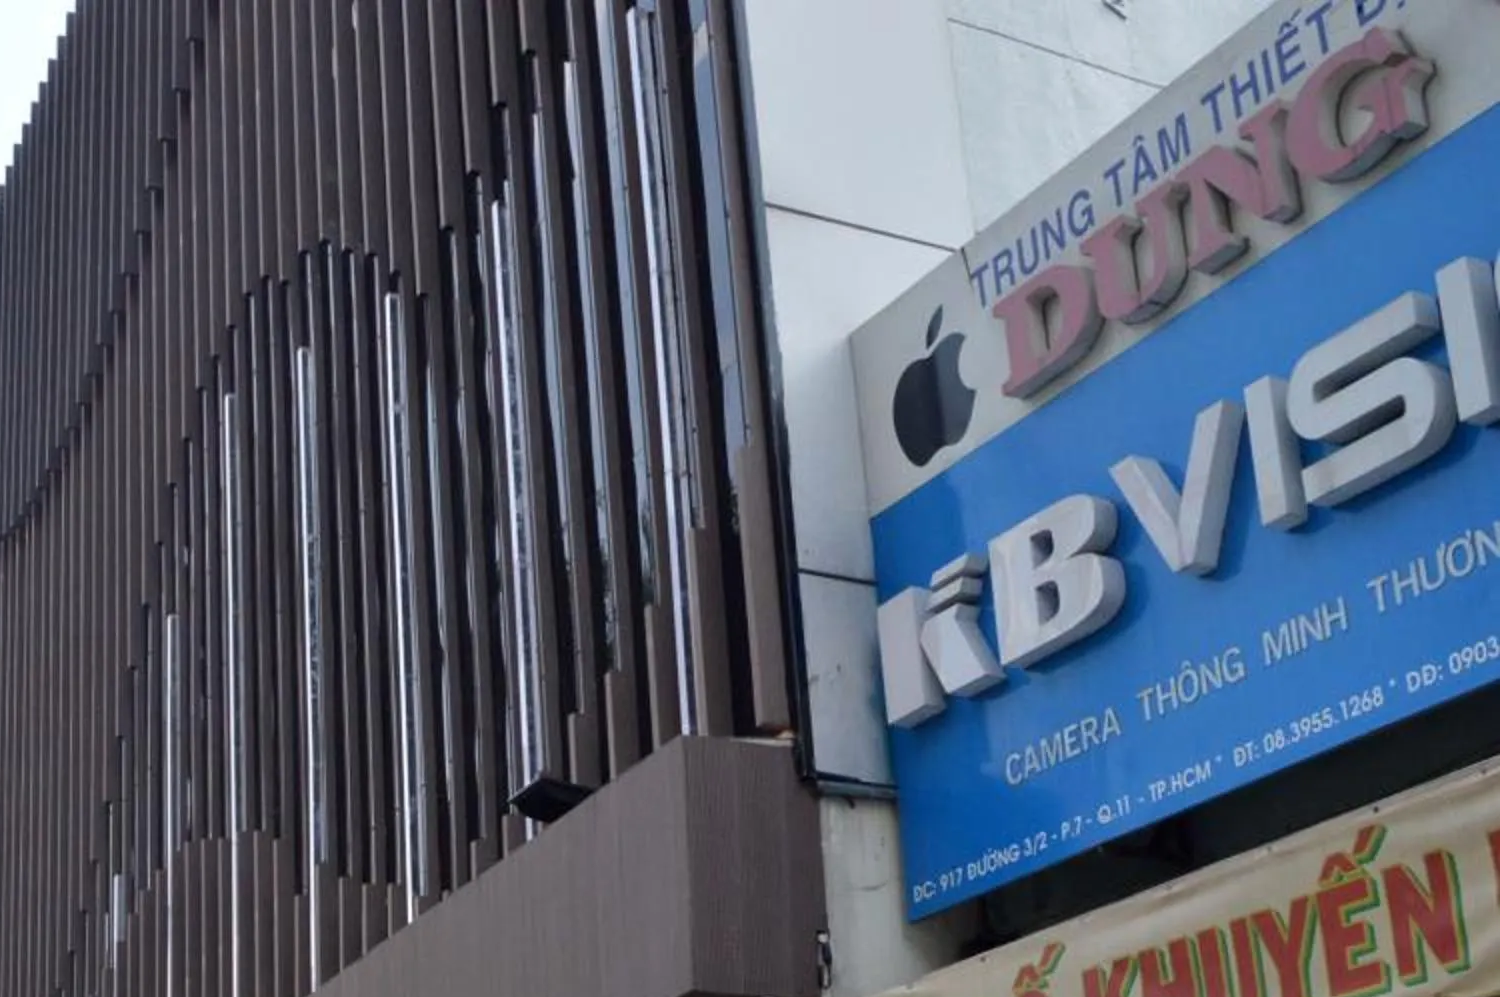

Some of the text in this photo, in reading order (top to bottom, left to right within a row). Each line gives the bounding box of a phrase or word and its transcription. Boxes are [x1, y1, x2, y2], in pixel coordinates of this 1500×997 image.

[970, 1, 1333, 308] TRUNG TÂM THIẾT
[877, 246, 1500, 729] KBVISI
[1005, 707, 1122, 786] CAMERA
[1136, 646, 1246, 722] THÔNG
[1261, 598, 1350, 667] MINH
[939, 867, 964, 893] 917
[1023, 830, 1050, 859] 3/2
[1148, 760, 1213, 803] TP.HCM
